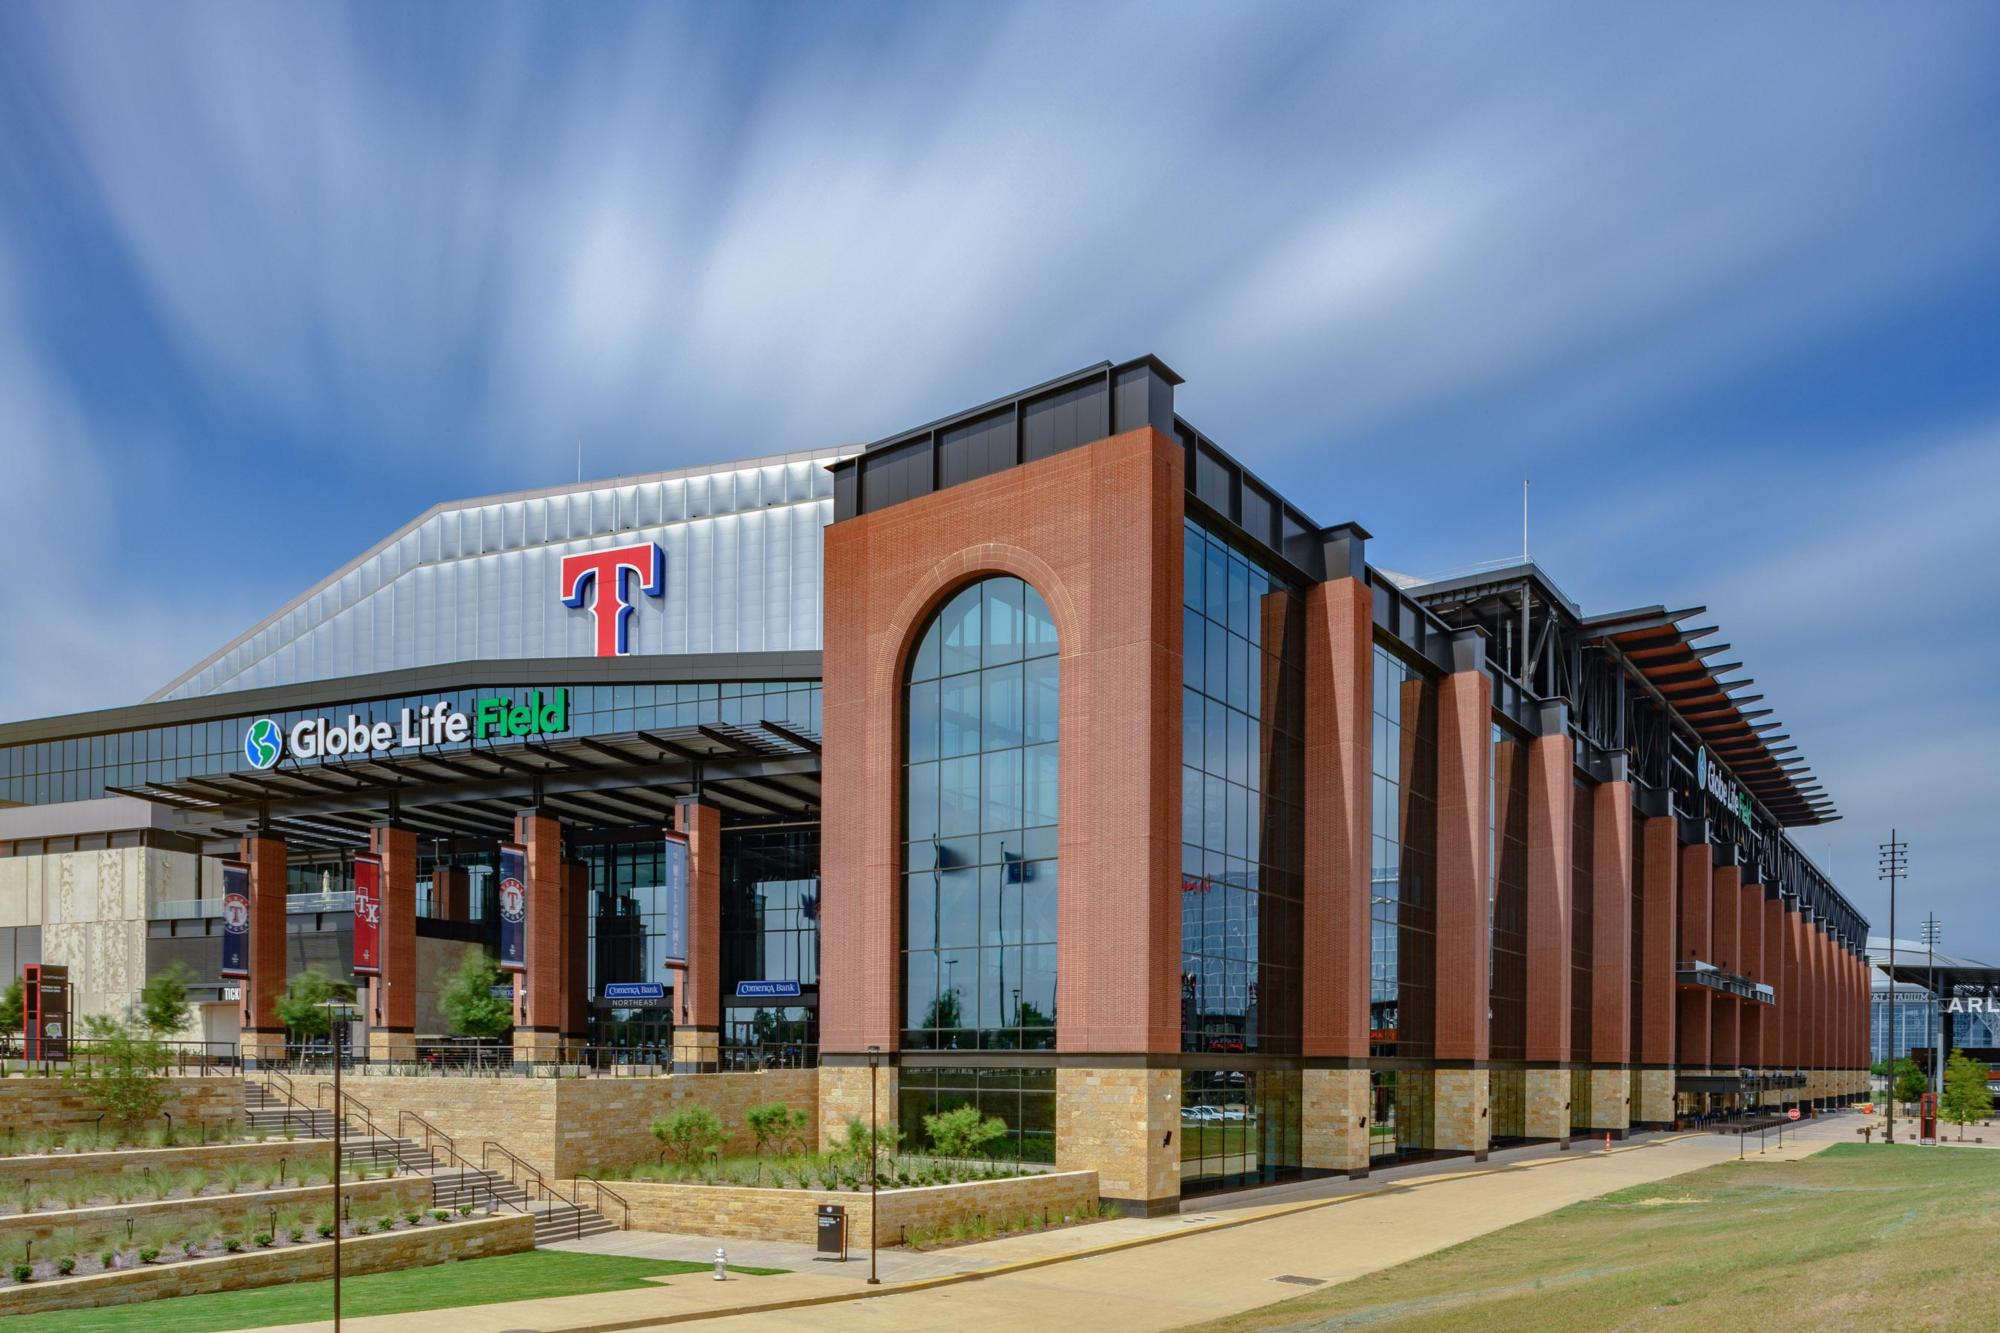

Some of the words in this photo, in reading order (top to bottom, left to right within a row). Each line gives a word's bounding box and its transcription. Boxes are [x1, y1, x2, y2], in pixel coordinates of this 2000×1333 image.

[560, 541, 662, 657] T
[290, 713, 391, 758] Globe
[401, 701, 467, 747] Life
[477, 688, 569, 740] Field
[1707, 760, 1728, 806] Globe
[1727, 780, 1739, 816] Life
[1739, 791, 1751, 827] Field
[223, 988, 240, 1001] TICK
[641, 985, 658, 993] Bank
[776, 983, 795, 992] Bank
[1872, 992, 1885, 1001] &T
[1947, 997, 2000, 1013] ARL
